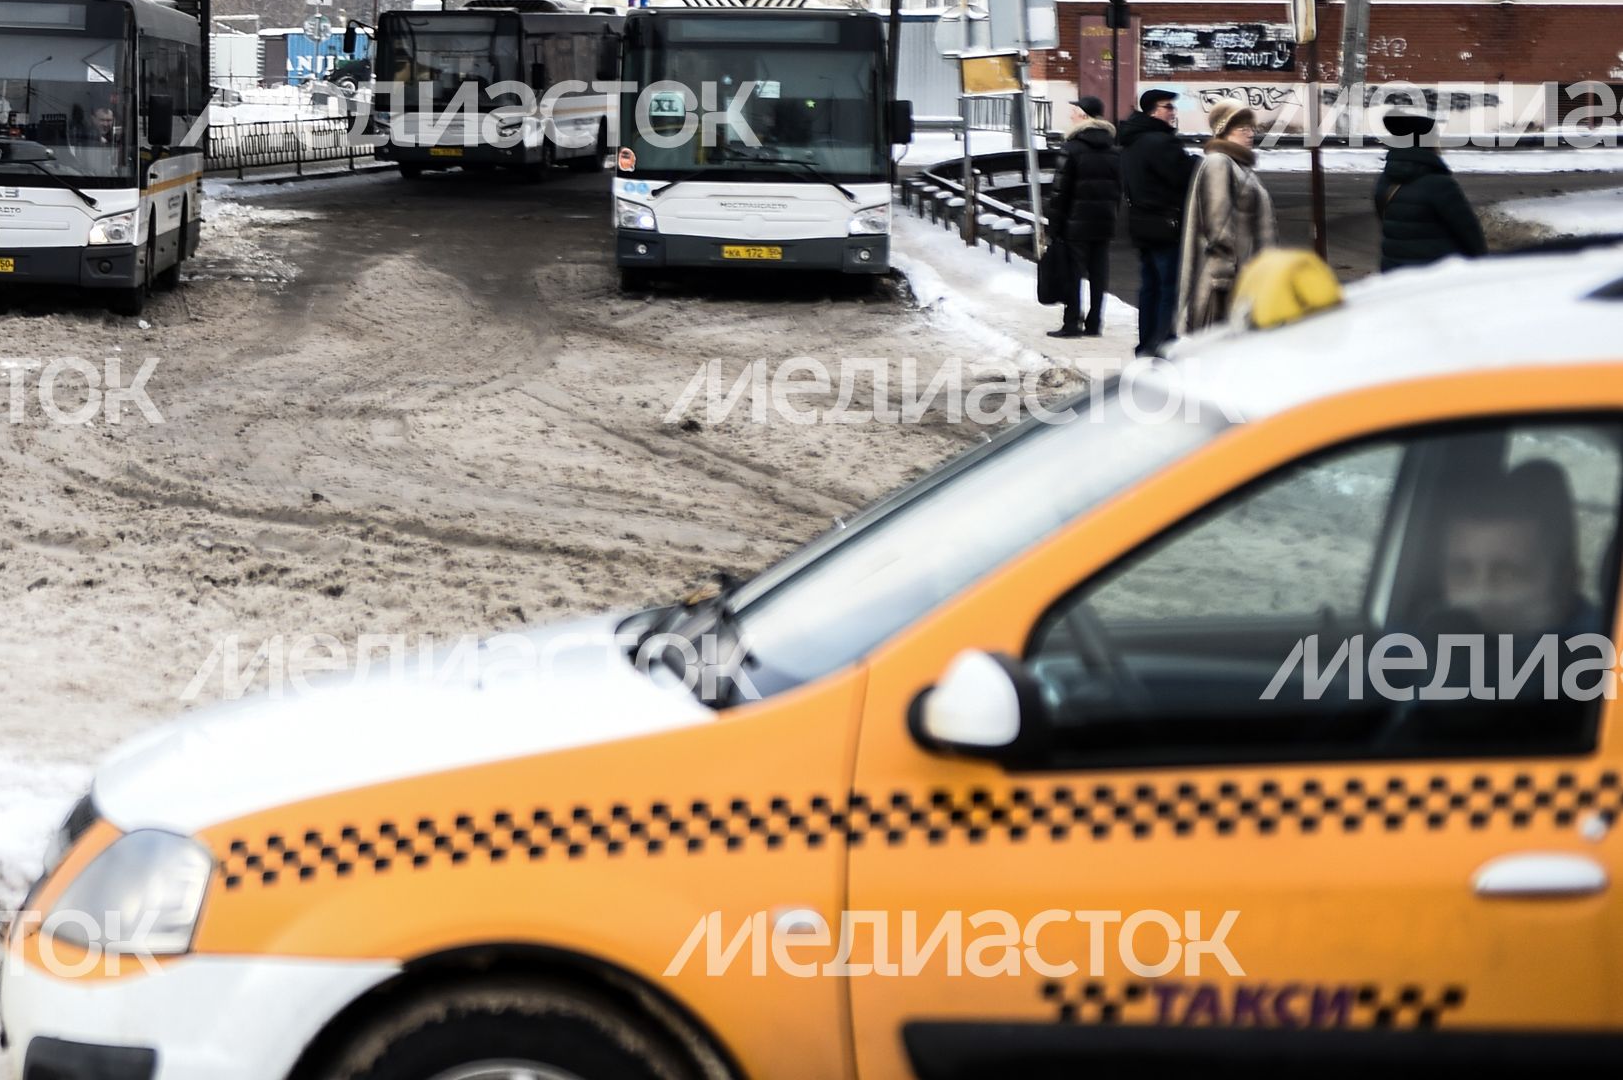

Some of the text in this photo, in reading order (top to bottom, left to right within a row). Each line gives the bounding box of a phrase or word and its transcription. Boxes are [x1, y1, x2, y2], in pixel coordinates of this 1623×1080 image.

[1227, 52, 1272, 67] ZAMUT
[653, 99, 679, 112] XL
[1150, 983, 1356, 1027] ТАКСИ
